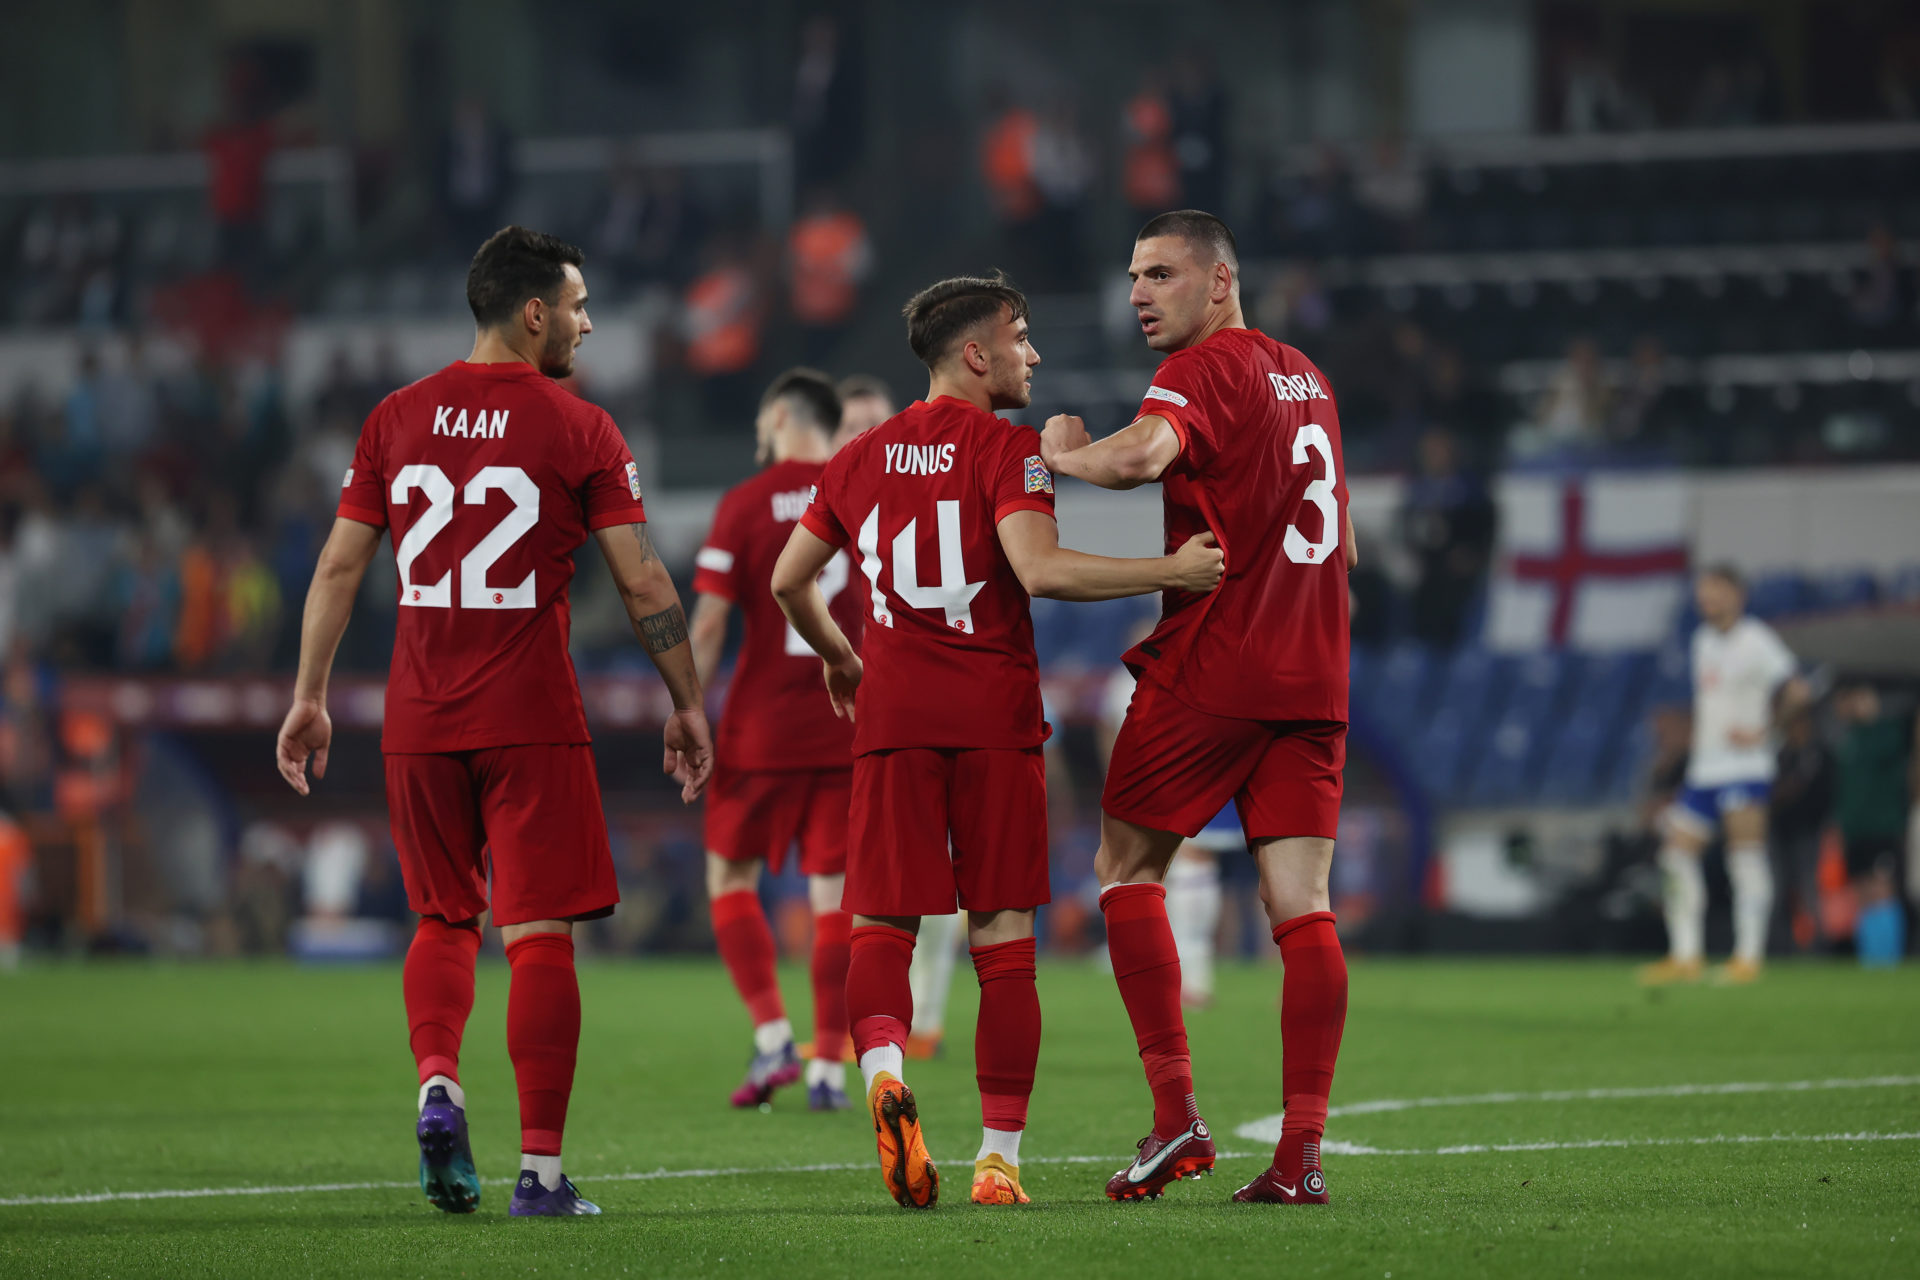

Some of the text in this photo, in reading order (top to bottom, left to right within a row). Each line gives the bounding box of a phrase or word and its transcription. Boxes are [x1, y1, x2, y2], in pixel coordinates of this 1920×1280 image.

[432, 405, 510, 439] KAAN
[884, 443, 956, 476] YUNUS
[391, 464, 541, 609] 22
[1282, 423, 1339, 565] 3
[857, 500, 988, 635] 14
